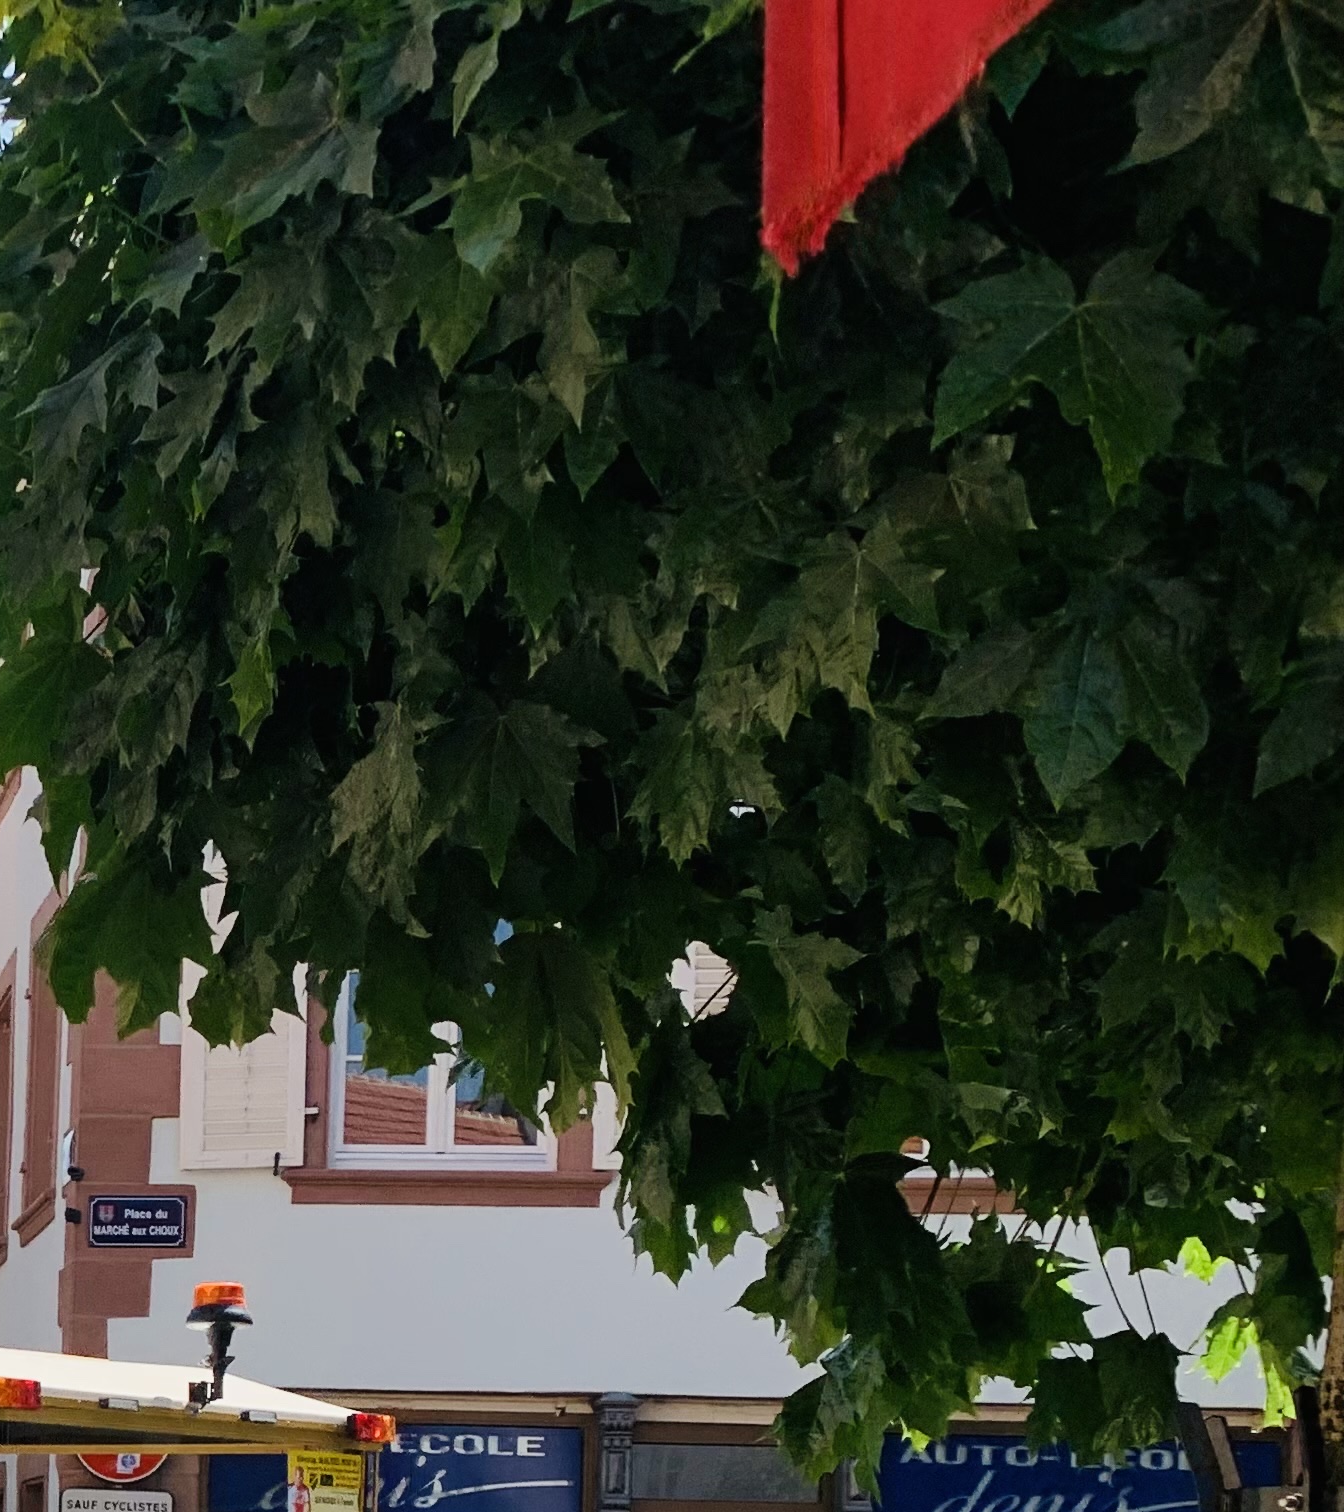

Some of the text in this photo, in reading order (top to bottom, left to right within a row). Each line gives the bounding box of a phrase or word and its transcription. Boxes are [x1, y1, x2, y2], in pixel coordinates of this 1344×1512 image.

[124, 1208, 169, 1219] Place du
[132, 1227, 147, 1236] aux
[149, 1225, 180, 1236] CHOUX
[390, 1433, 546, 1457] ECOLE
[66, 1499, 169, 1512] SAUF CYCLISTES
